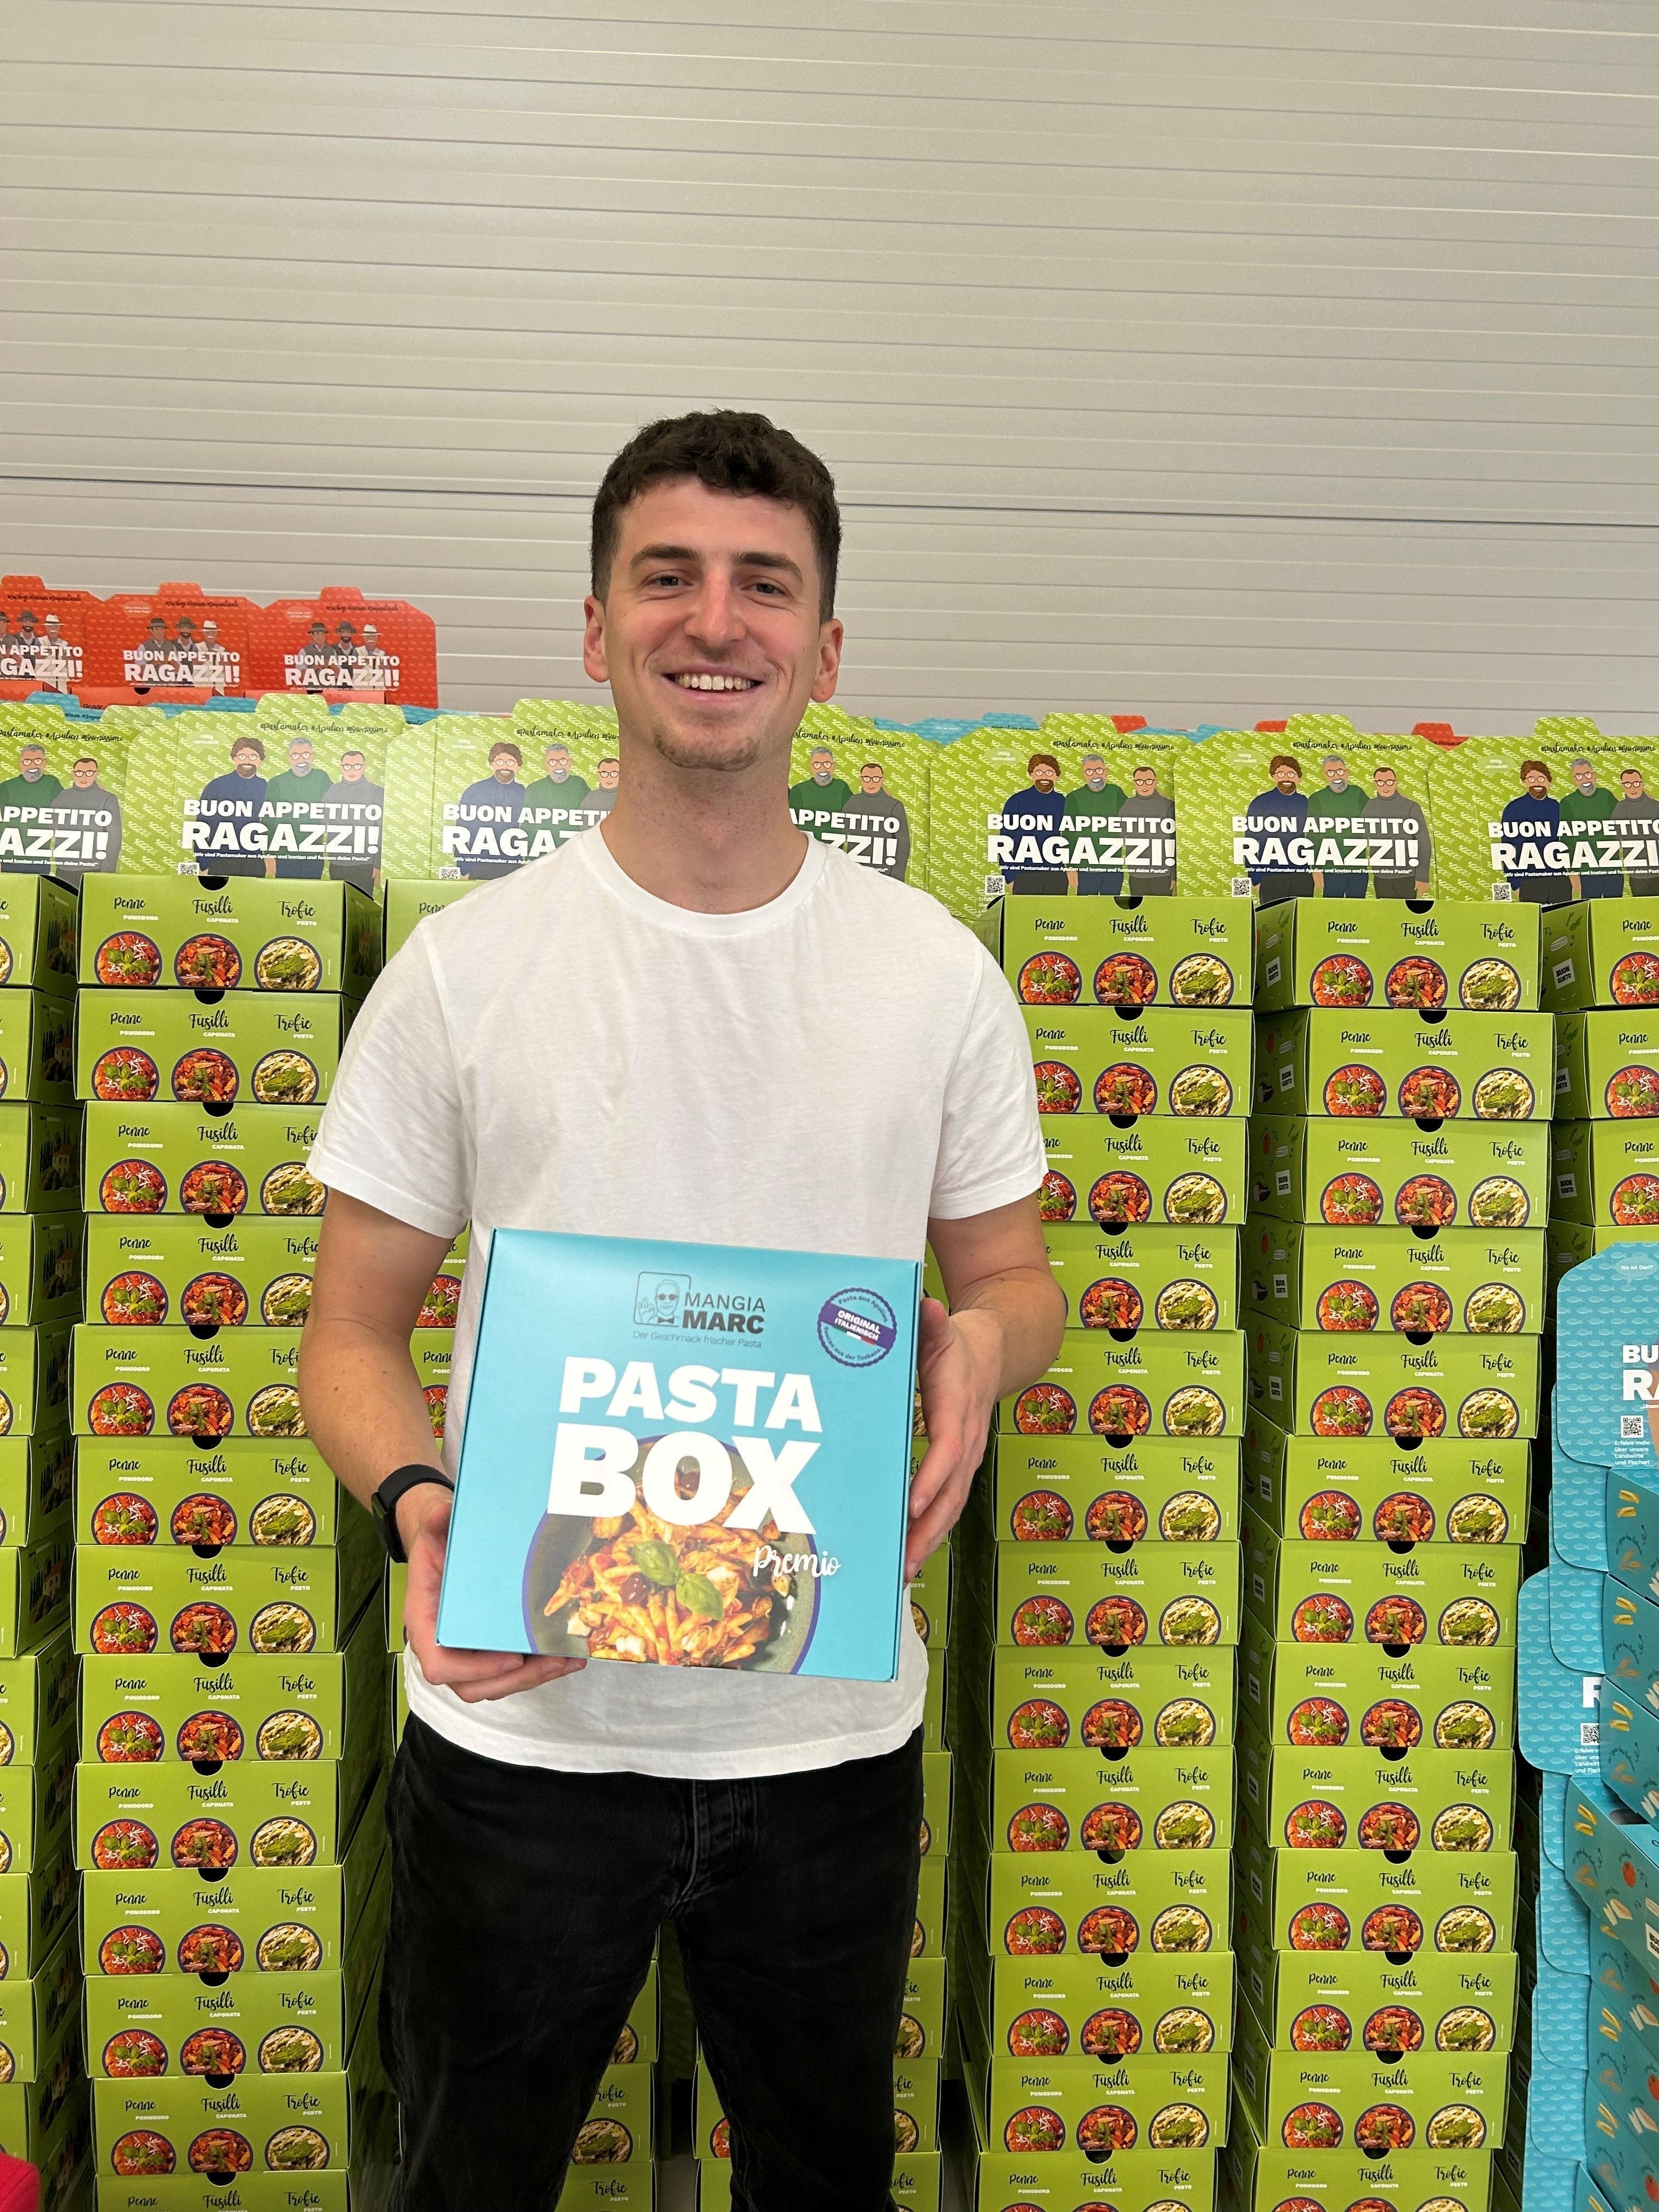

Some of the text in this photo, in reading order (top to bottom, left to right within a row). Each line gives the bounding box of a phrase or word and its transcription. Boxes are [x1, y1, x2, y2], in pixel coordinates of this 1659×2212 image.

[10, 646, 83, 657] APPETITO
[123, 650, 240, 663] BUON APPETITO
[284, 654, 400, 667] BUON APPETITO
[0, 658, 83, 678] GAZZI!
[125, 664, 240, 682] RAGAZZI!
[285, 668, 399, 686] RAGAZZI!
[0, 806, 112, 826] PPETITO
[184, 799, 382, 821] BUON APPETITO
[443, 804, 611, 826] BUON APPETI
[988, 814, 1176, 834] BUON APPETITO
[1232, 816, 1419, 834] BUON APPETITO
[1488, 821, 1551, 838] BUON
[0, 828, 109, 860] AZZI!
[182, 821, 380, 854] RAGAZZI!
[442, 825, 582, 857] RAGA
[987, 834, 1175, 867] RAGAZZI!
[1233, 837, 1419, 867] RAGAZZI!
[1491, 840, 1659, 870] RAGAZZI
[114, 898, 146, 909] Penne
[192, 896, 233, 915] Fusilli
[277, 901, 315, 918] Trofie
[1035, 919, 1065, 930] Penne
[1109, 915, 1148, 934] Fusilli
[1190, 918, 1226, 935] Trofie
[1328, 921, 1358, 933] Penne
[1401, 919, 1439, 938] Fusilli
[1480, 923, 1515, 941] Trofie
[1338, 1140, 1368, 1151] Penne
[1410, 1137, 1448, 1156] Fusilli
[1488, 1141, 1524, 1159] Trofie
[685, 1291, 765, 1312] MANGIA
[682, 1309, 764, 1334] MARC
[834, 1317, 879, 1341] ITALIENISCH
[837, 1310, 881, 1334] ORIGINAL
[633, 1330, 761, 1348] Der Geschmack frischer Pasta
[1623, 1345, 1659, 1363] BU
[558, 1356, 823, 1433] PASTA
[109, 1459, 141, 1471] Penne
[186, 1455, 227, 1475] Fusilli
[270, 1457, 309, 1476] Trofie
[1028, 1458, 1058, 1469] Penne
[1101, 1454, 1139, 1473] Fusilli
[1180, 1456, 1215, 1474] Trofie
[547, 1422, 821, 1535] BOX
[753, 1545, 842, 1578] Premio
[1307, 1871, 1336, 1882] Penne
[1378, 1869, 1416, 1887] Fusilli
[1457, 1872, 1492, 1889] Trofie
[116, 1893, 147, 1905] Penne
[193, 1887, 234, 1906] Fusilli
[278, 1888, 315, 1905] Trofie
[1024, 1977, 1053, 1989] Penne
[1096, 1972, 1133, 1991] Fusilli
[1174, 1973, 1209, 1990] Trofie
